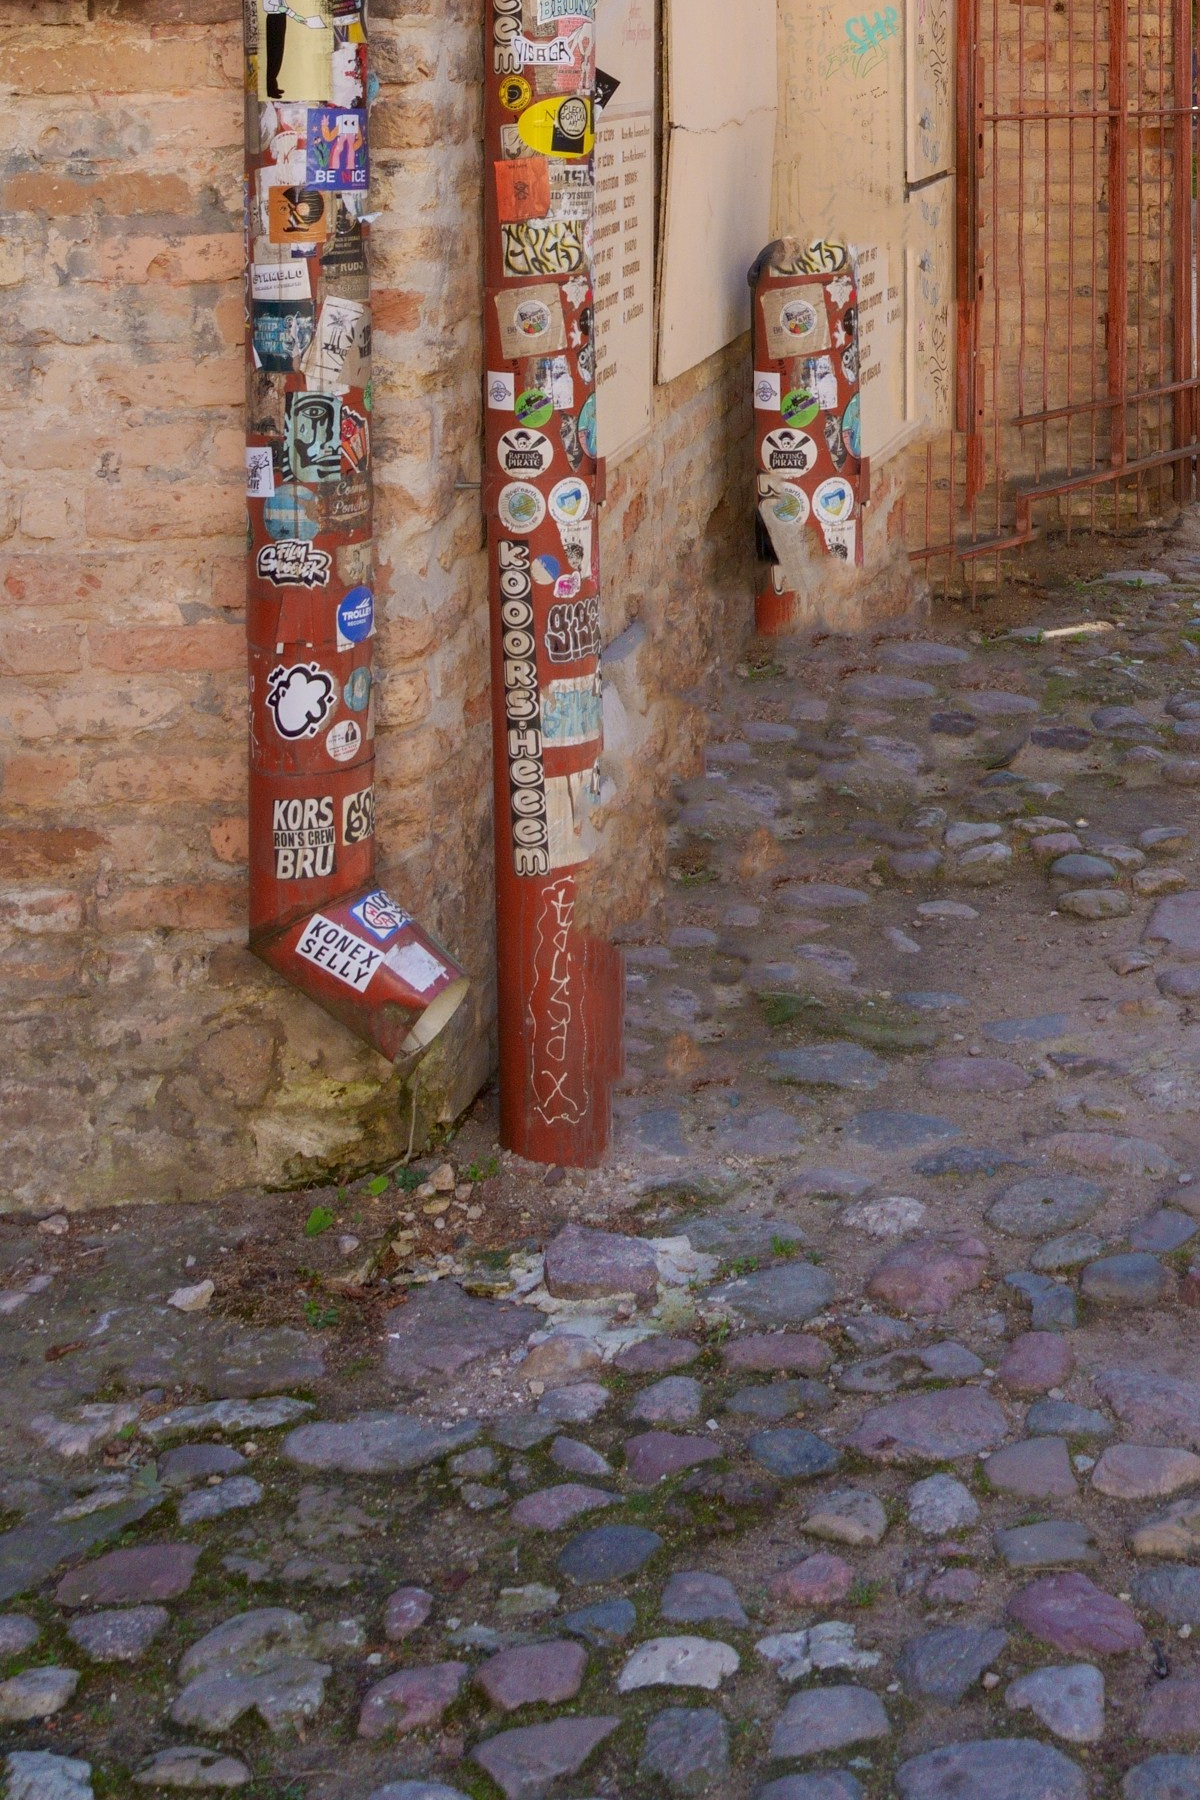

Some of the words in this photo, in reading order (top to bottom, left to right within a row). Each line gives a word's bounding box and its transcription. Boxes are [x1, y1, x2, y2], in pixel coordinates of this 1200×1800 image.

[315, 169, 336, 184] BE
[341, 169, 366, 184] NICE
[508, 452, 540, 461] RAFTING
[508, 459, 541, 467] PIRATE
[272, 796, 334, 831] KORS
[273, 830, 305, 848] RON'S
[307, 827, 335, 846] CREW
[275, 846, 335, 879] BRU
[309, 920, 380, 969] KONEX
[300, 938, 370, 985] SELLY
